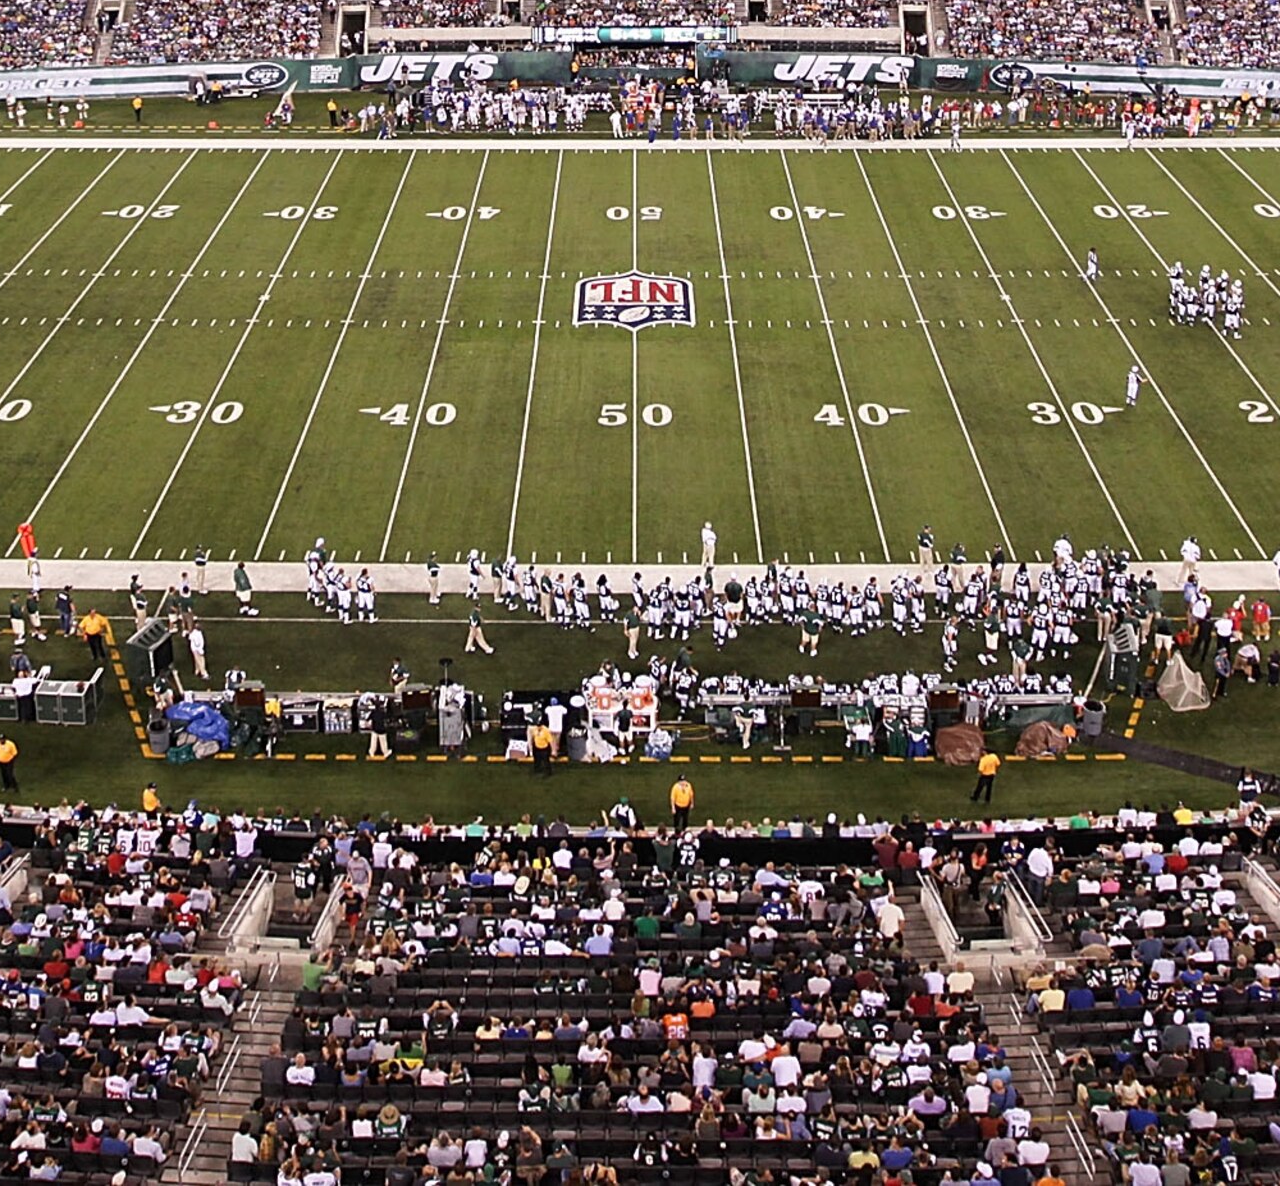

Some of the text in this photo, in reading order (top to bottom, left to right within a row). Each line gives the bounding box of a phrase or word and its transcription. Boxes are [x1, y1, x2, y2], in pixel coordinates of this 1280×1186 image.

[360, 54, 499, 83] JETS
[773, 54, 915, 83] JETS
[39, 77, 93, 90] JETS
[1220, 78, 1268, 92] NEW
[119, 205, 180, 218] 20
[281, 206, 339, 219] 30
[443, 207, 501, 219] 40
[606, 206, 663, 220] 50
[770, 207, 827, 220] 40
[933, 206, 990, 219] 30
[1094, 205, 1153, 218] 20
[590, 278, 680, 303] NFL
[167, 401, 244, 424] 30
[380, 403, 457, 425] 40
[597, 402, 673, 426] 50
[814, 404, 888, 426] 40
[1028, 402, 1103, 424] 30
[998, 681, 1011, 692] 70
[120, 839, 127, 852] 6
[140, 839, 151, 853] 10
[680, 851, 695, 865] 73
[1148, 1038, 1157, 1052] 6
[1012, 1124, 1028, 1138] 12
